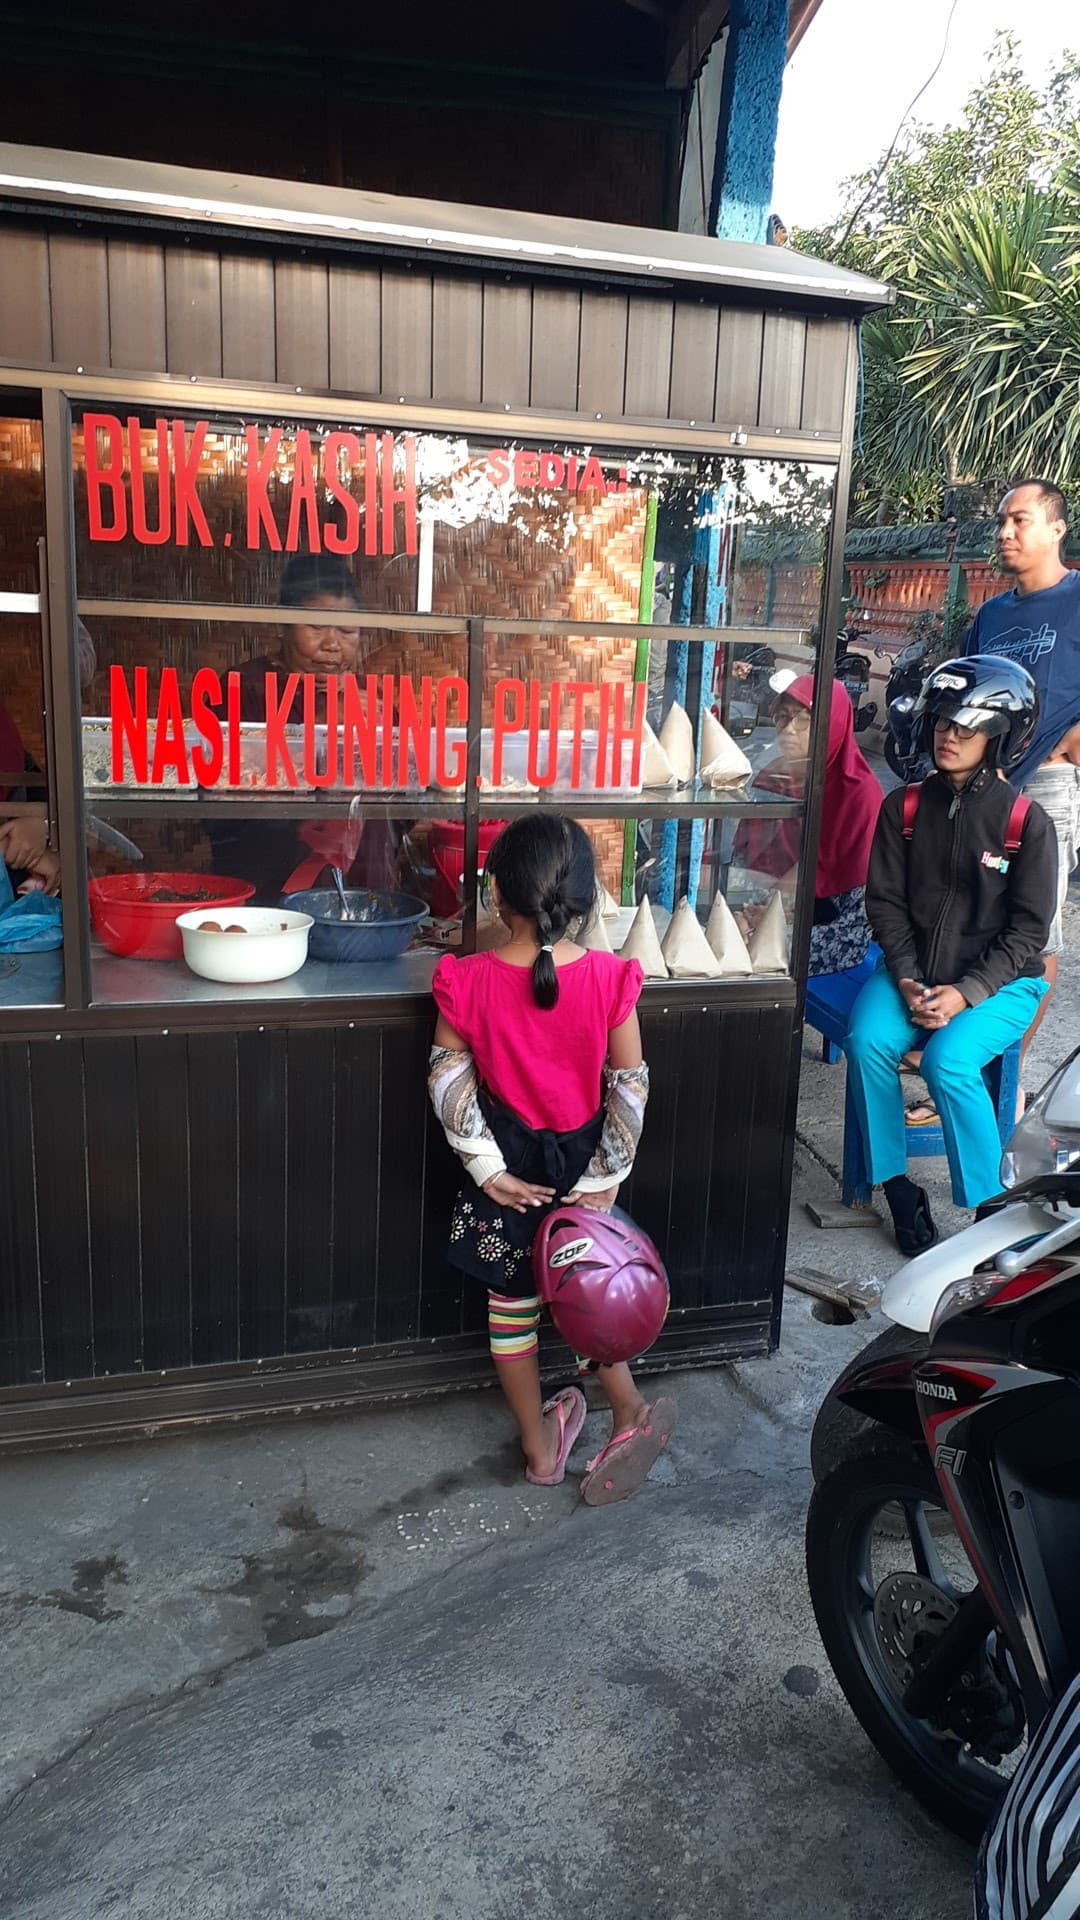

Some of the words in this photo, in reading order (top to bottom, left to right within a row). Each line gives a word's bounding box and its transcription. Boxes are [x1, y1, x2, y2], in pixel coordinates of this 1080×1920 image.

[246, 425, 418, 556] KASIH
[492, 679, 646, 789] PUTIH
[916, 1380, 958, 1402] HONDA
